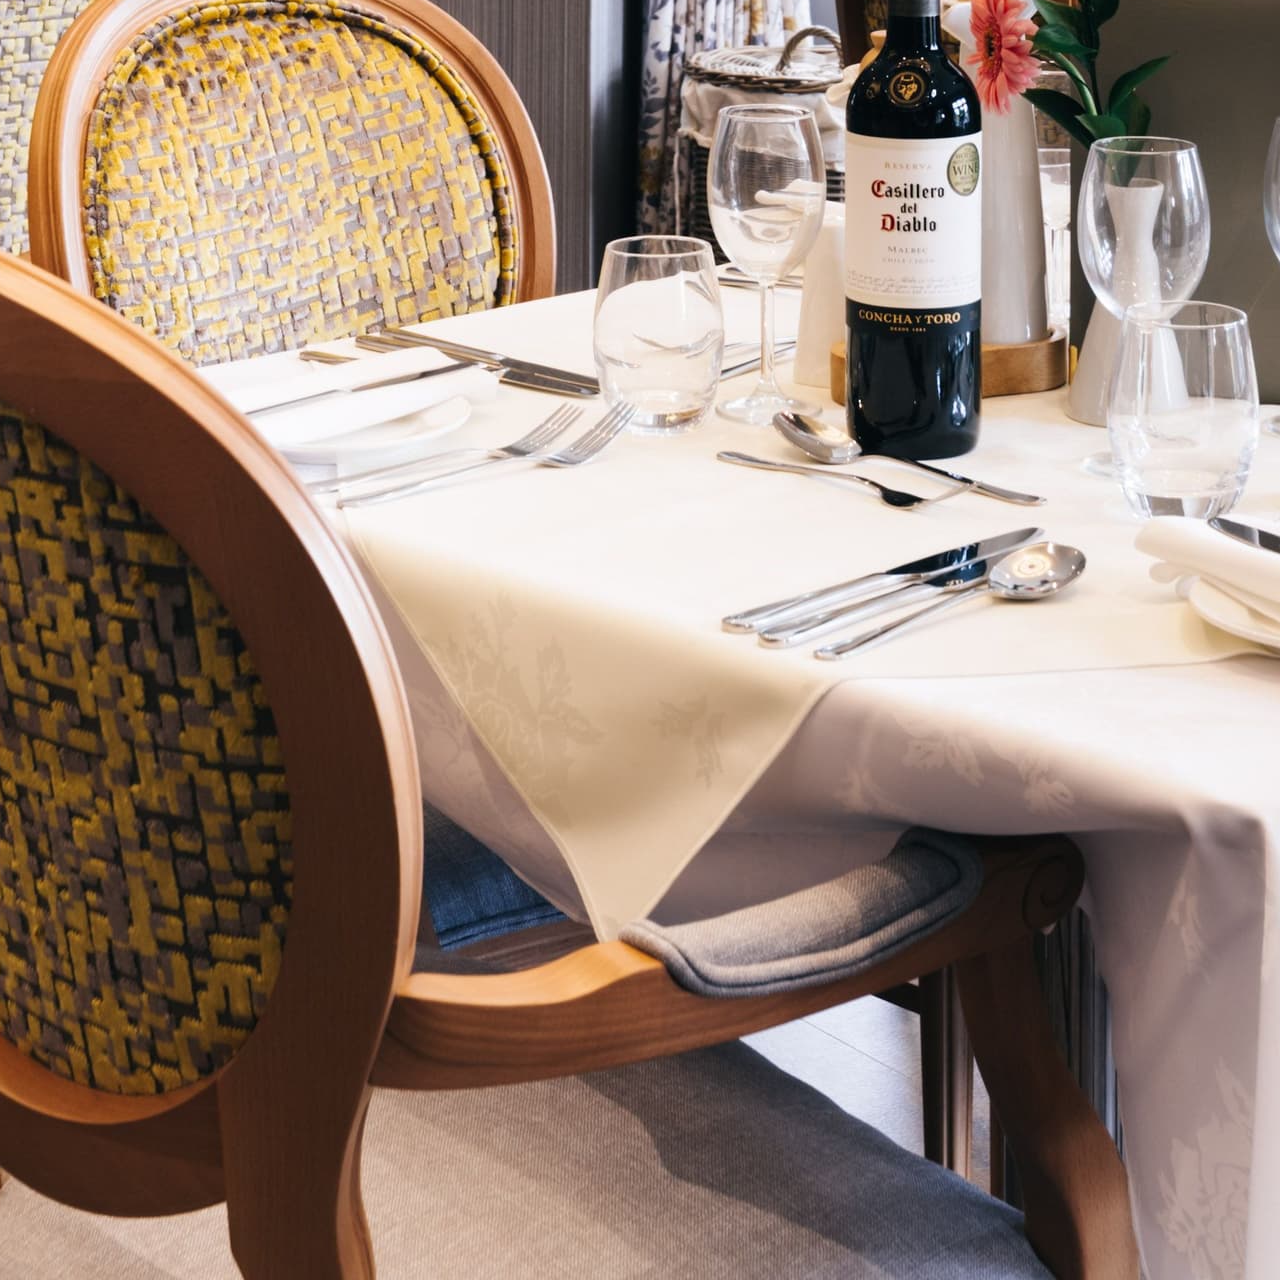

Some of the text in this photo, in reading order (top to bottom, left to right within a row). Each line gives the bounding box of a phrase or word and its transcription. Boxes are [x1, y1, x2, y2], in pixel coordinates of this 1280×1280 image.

[884, 161, 933, 169] RESERVA
[871, 180, 945, 199] Casillero
[900, 203, 917, 214] del
[881, 214, 937, 232] Diablo
[888, 245, 928, 254] MALBEC
[858, 309, 912, 324] CONCHA
[915, 315, 922, 323] Y
[924, 312, 961, 325] TORO
